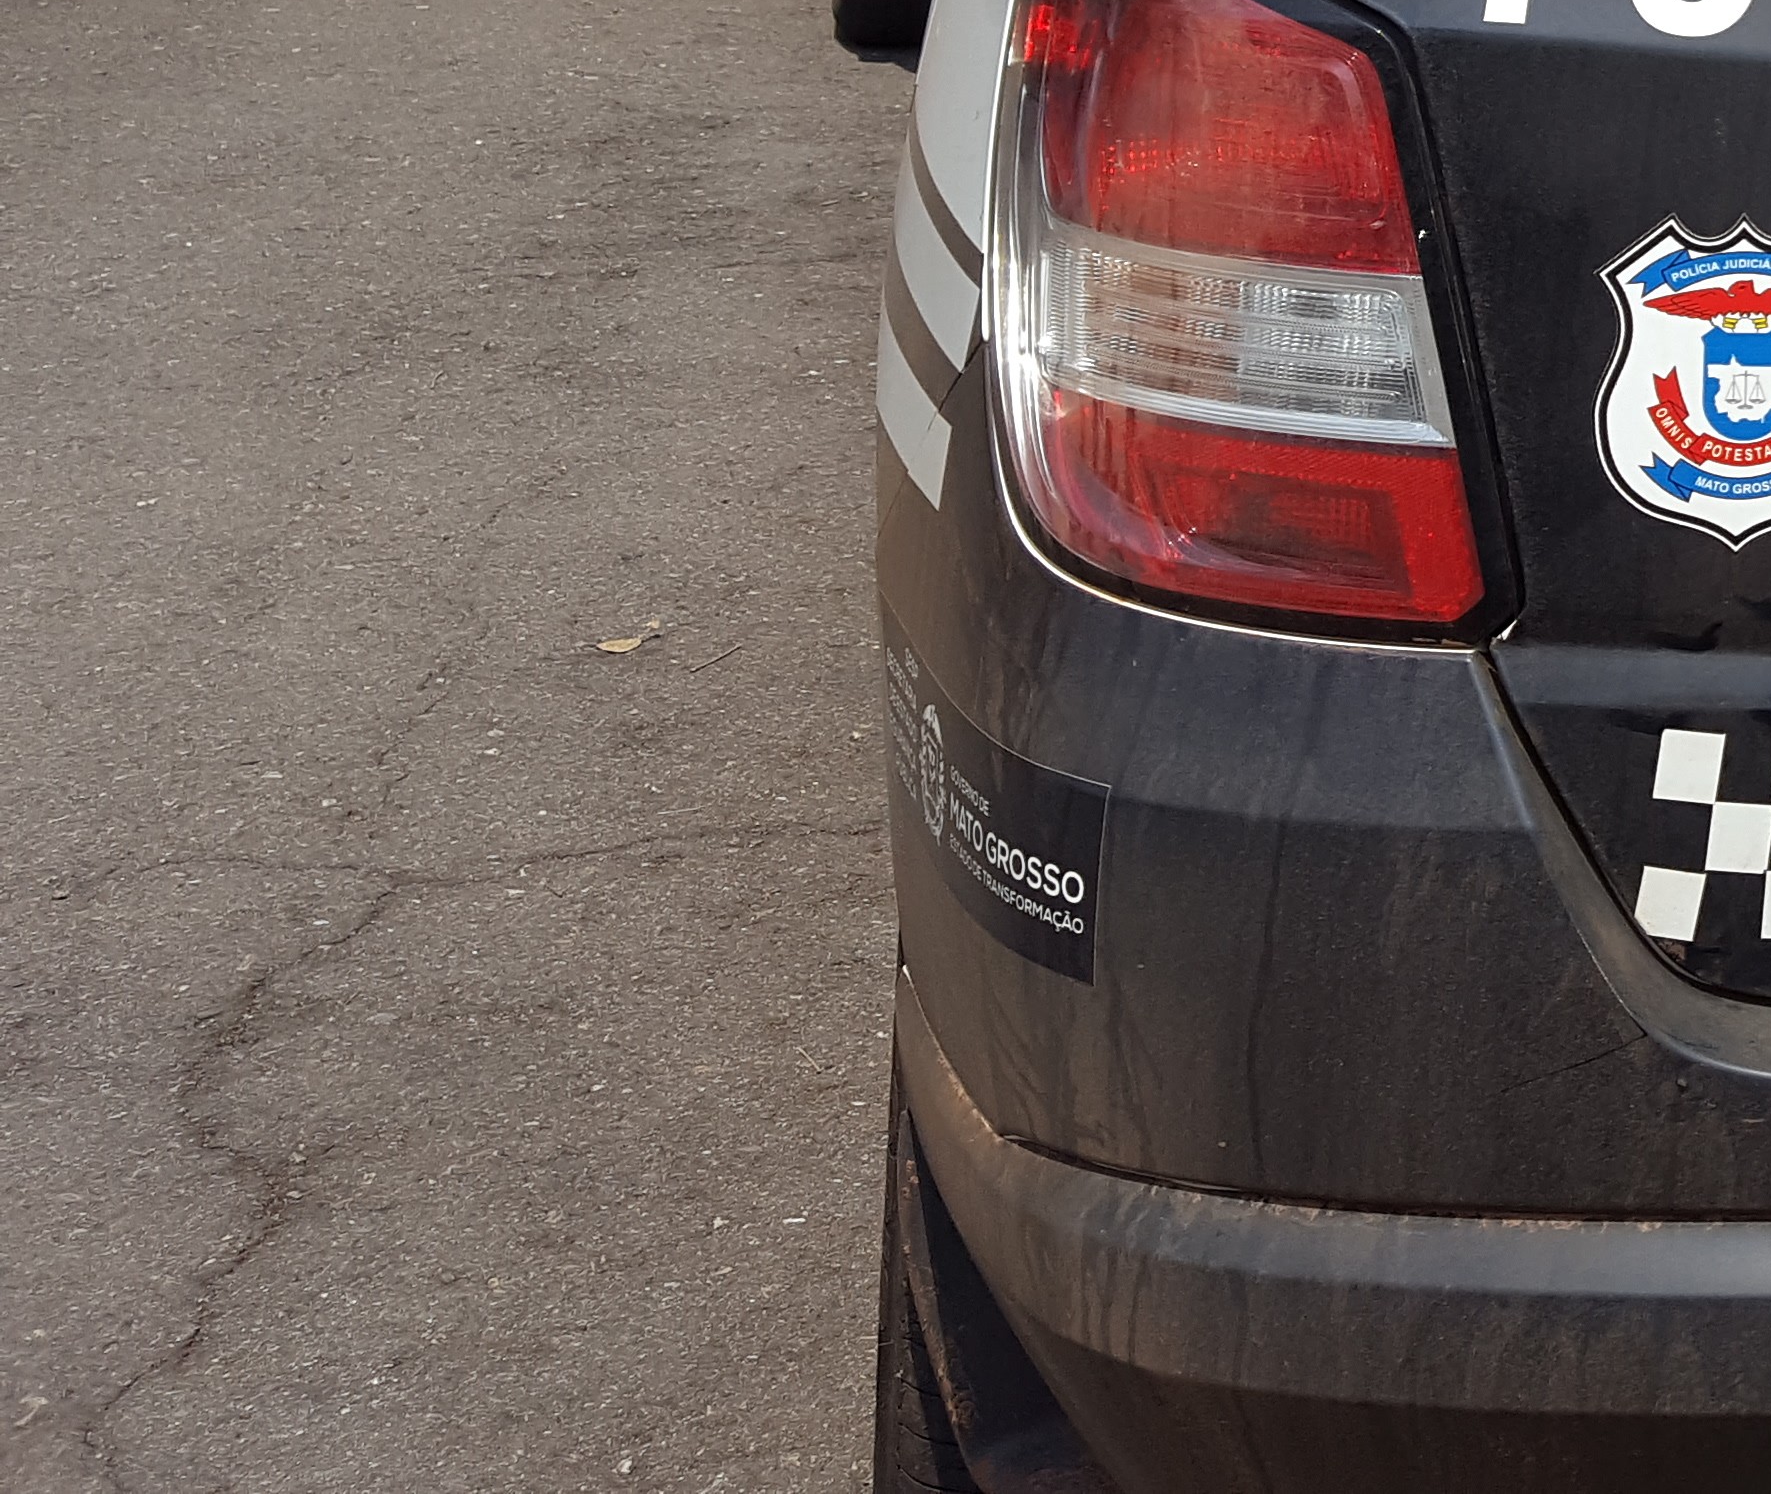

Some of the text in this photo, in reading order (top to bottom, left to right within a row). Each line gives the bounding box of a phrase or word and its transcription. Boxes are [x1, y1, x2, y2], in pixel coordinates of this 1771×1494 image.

[1670, 258, 1720, 283] POLÍCIA
[1655, 407, 1695, 451] OMNIS
[1694, 475, 1731, 493] MATO
[950, 792, 1085, 904] MATO GROSSO
[981, 869, 1085, 935] TRANSFORMAÇÃO
